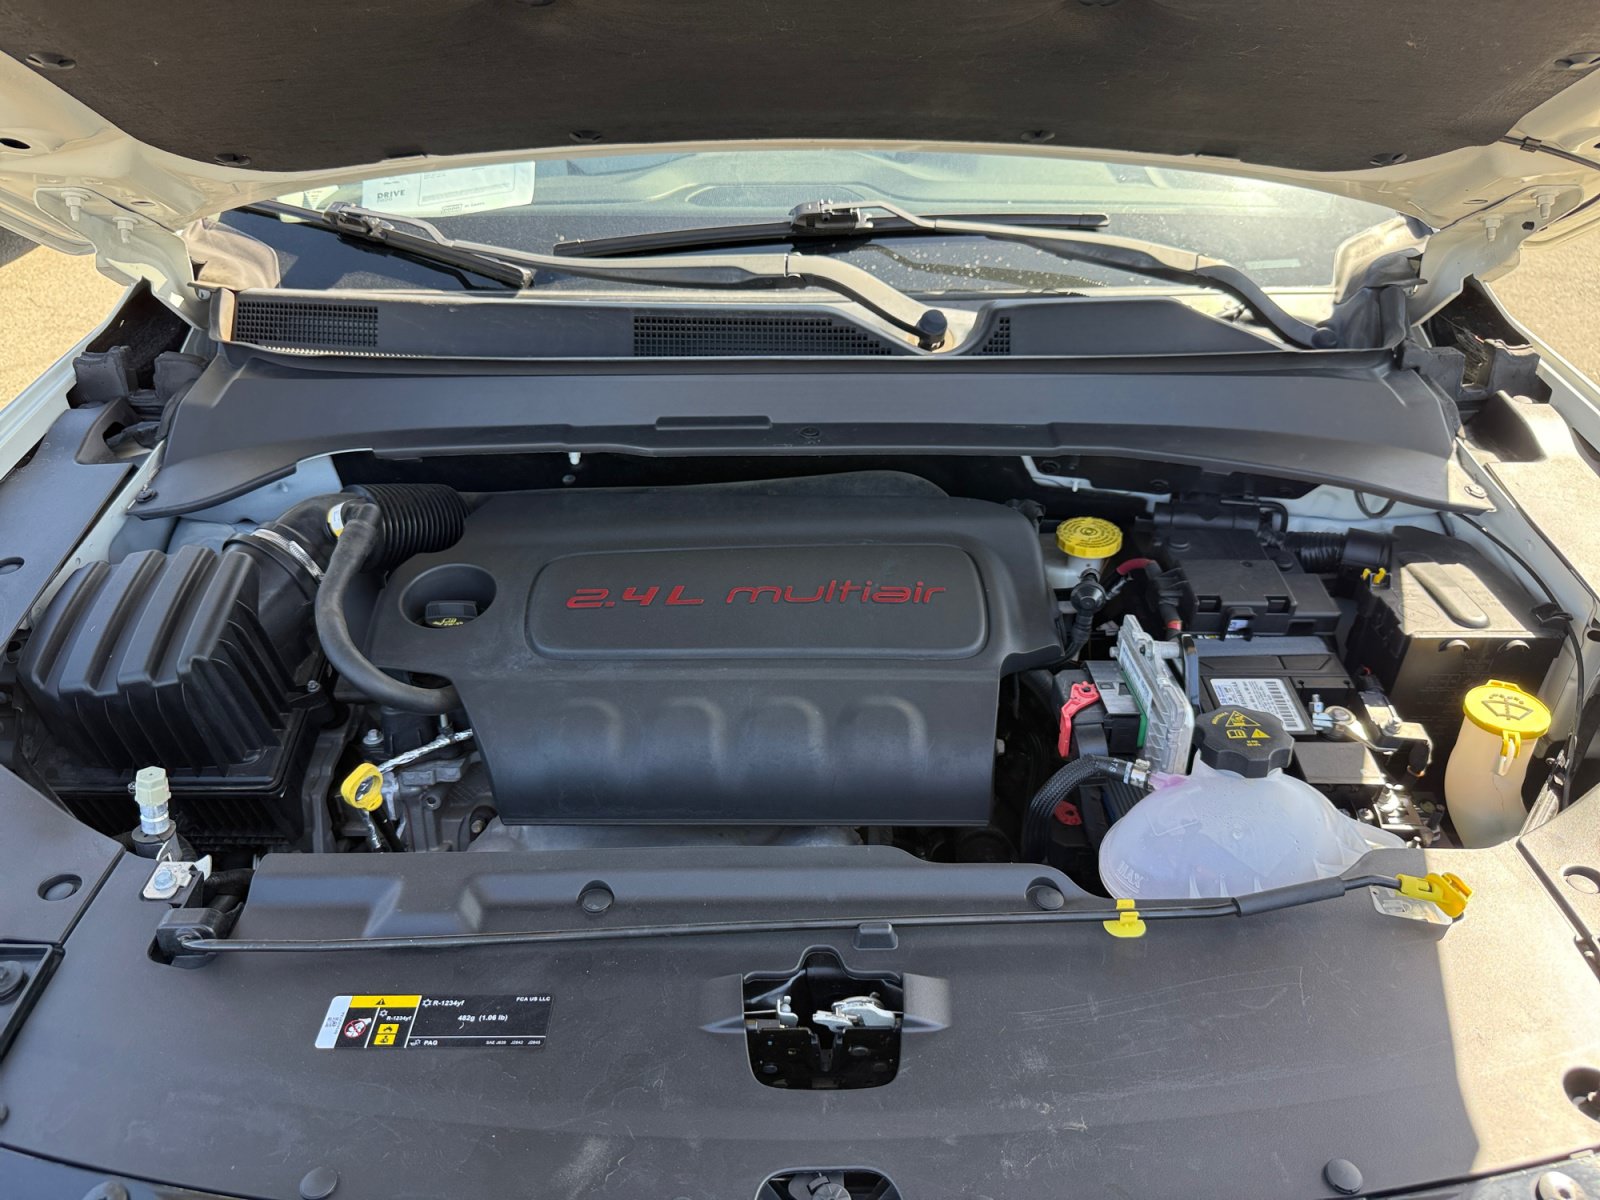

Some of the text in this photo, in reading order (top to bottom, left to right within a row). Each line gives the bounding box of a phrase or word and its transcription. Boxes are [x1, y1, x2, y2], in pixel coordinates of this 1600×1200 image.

[377, 189, 406, 199] DRIVE
[726, 579, 946, 604] multiair
[432, 999, 466, 1007] R-1234yf
[457, 1014, 476, 1022] 482g
[497, 1014, 508, 1022] lb)
